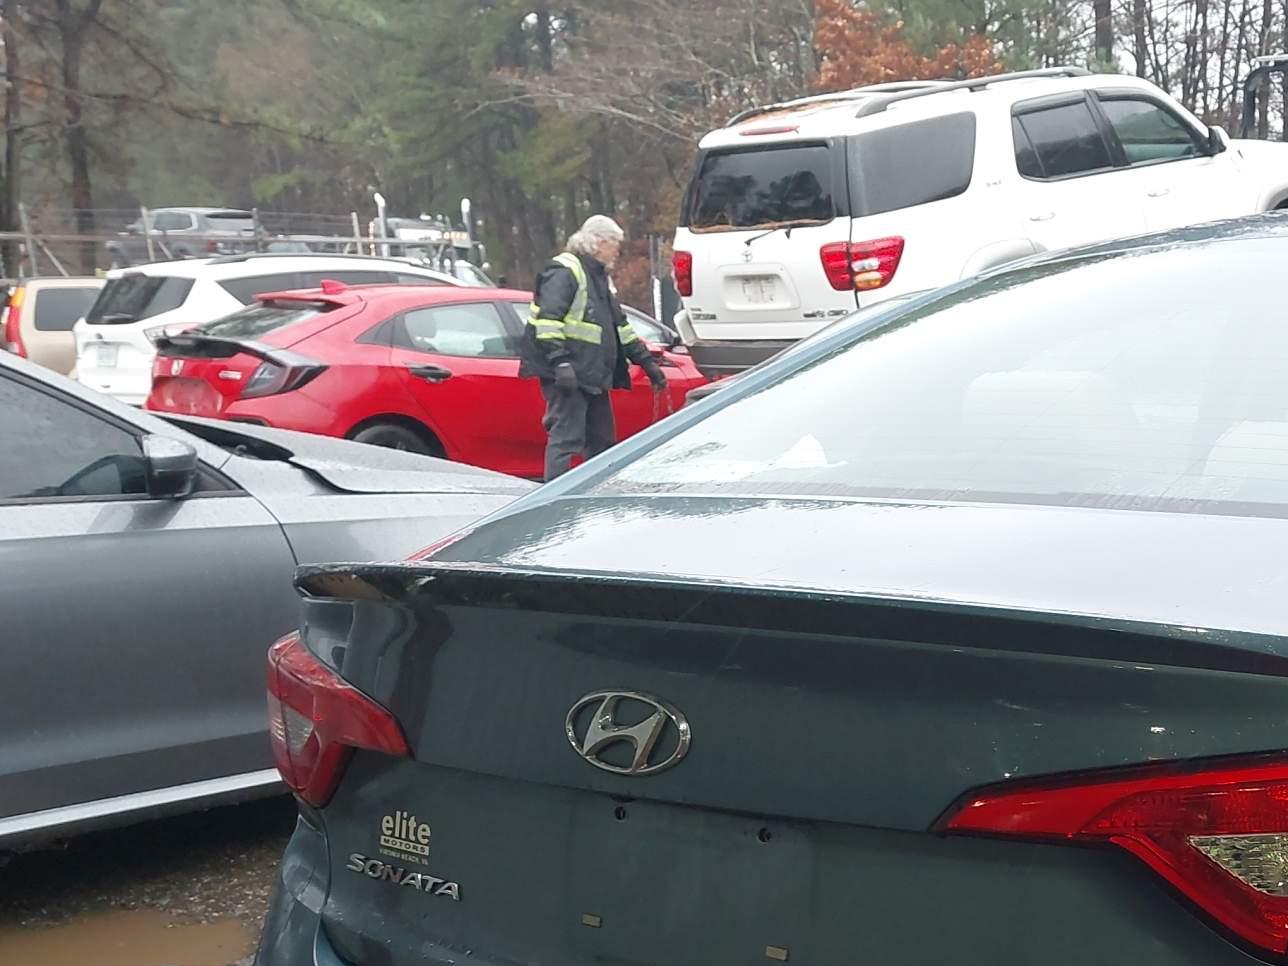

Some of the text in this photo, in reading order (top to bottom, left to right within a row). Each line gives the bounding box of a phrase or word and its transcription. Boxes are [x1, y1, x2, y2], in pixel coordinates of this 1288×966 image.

[382, 811, 431, 844] elite
[383, 838, 426, 853] MOTORS
[346, 853, 460, 901] SONATA
